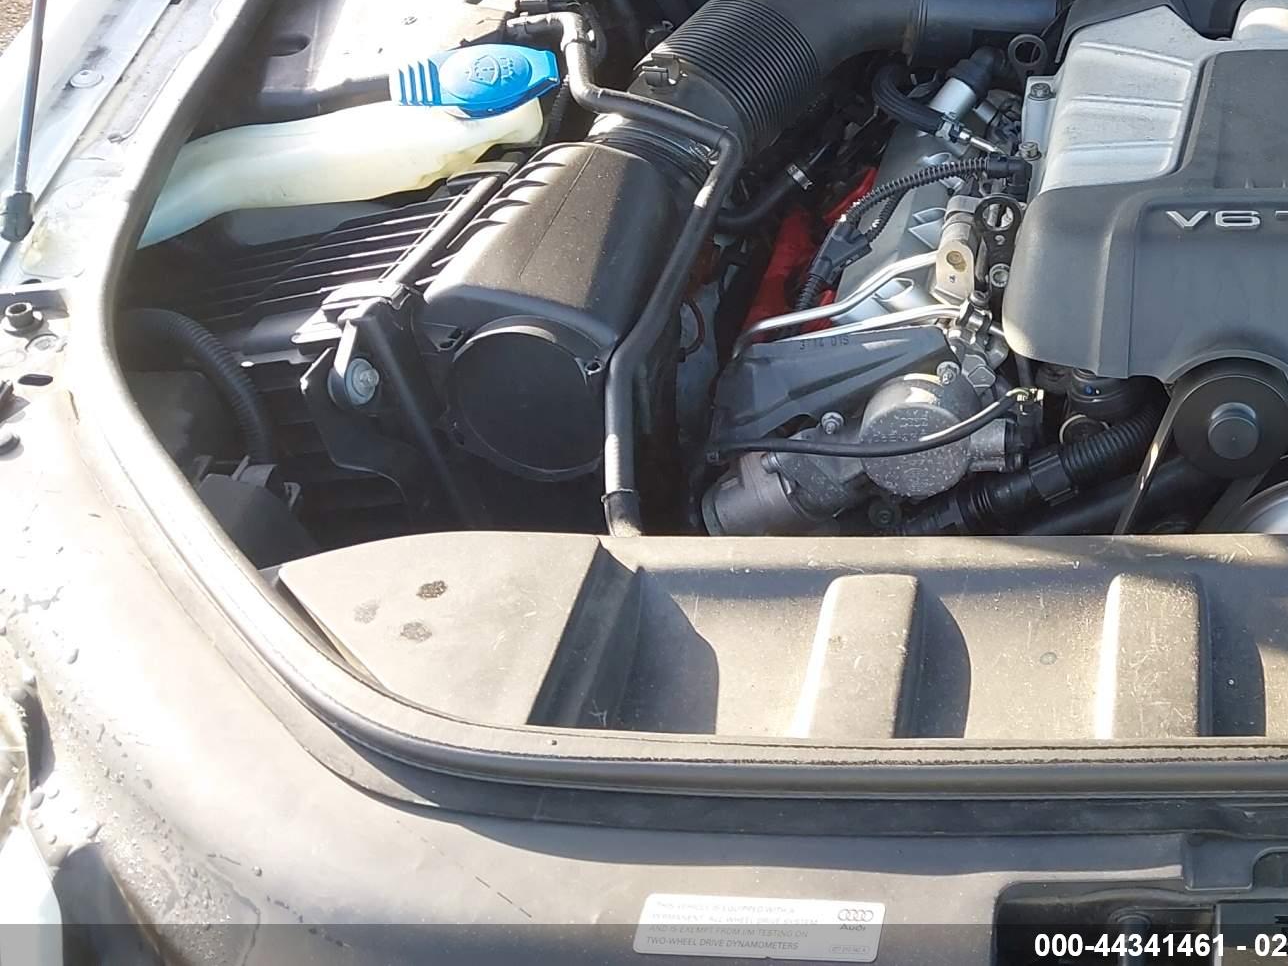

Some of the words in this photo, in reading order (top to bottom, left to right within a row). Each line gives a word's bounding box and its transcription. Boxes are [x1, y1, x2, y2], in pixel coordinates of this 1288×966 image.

[1166, 210, 1261, 230] V6
[839, 923, 866, 931] Audi
[647, 936, 697, 946] TWO-WHEEL
[698, 938, 724, 947] DRIVE
[725, 939, 799, 950] DYNAMOMETERS
